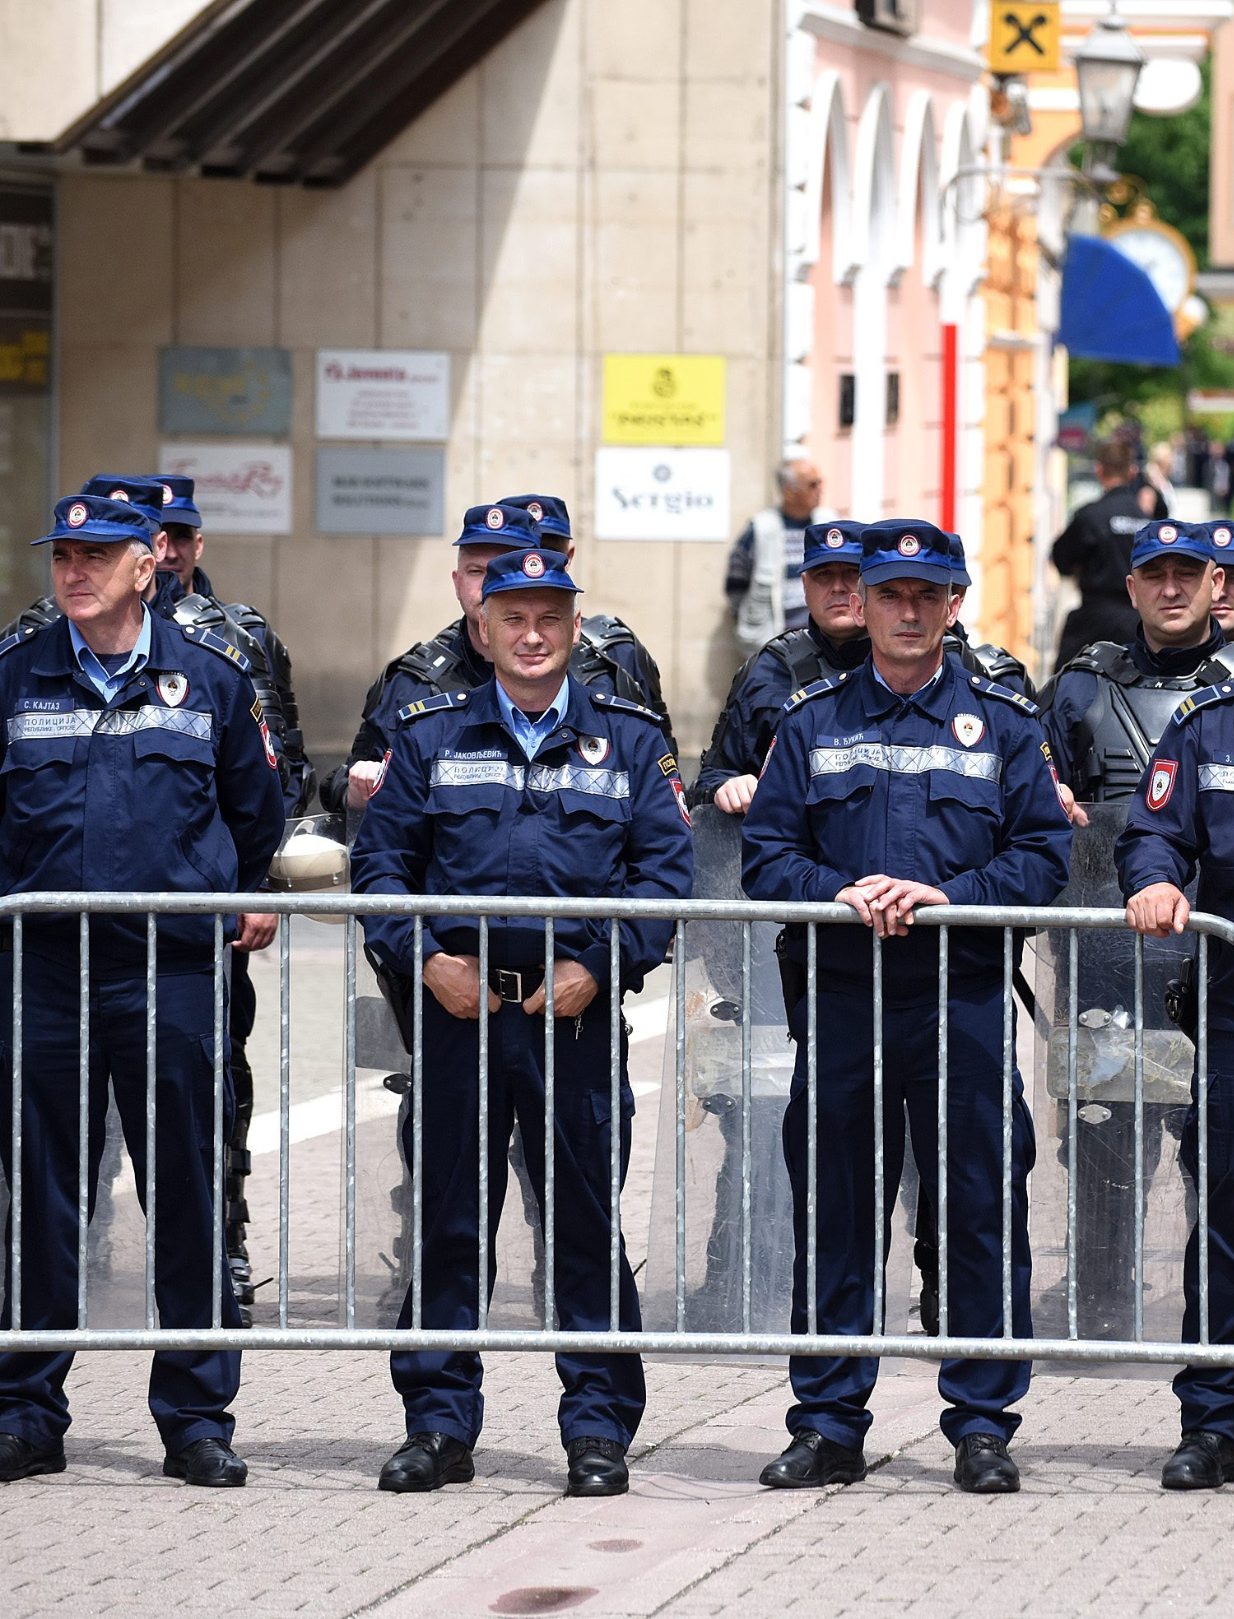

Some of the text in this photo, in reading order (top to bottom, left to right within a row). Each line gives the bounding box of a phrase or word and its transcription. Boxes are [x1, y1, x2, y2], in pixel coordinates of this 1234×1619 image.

[612, 486, 714, 514] Sergio
[24, 701, 60, 710] С. КАЈТАЗ
[24, 716, 76, 726] ПОЛИЦИЈА
[833, 732, 864, 746] В. ЂУКИЋ
[444, 749, 502, 760] Р. ЈАКОВЉЕВИЋ
